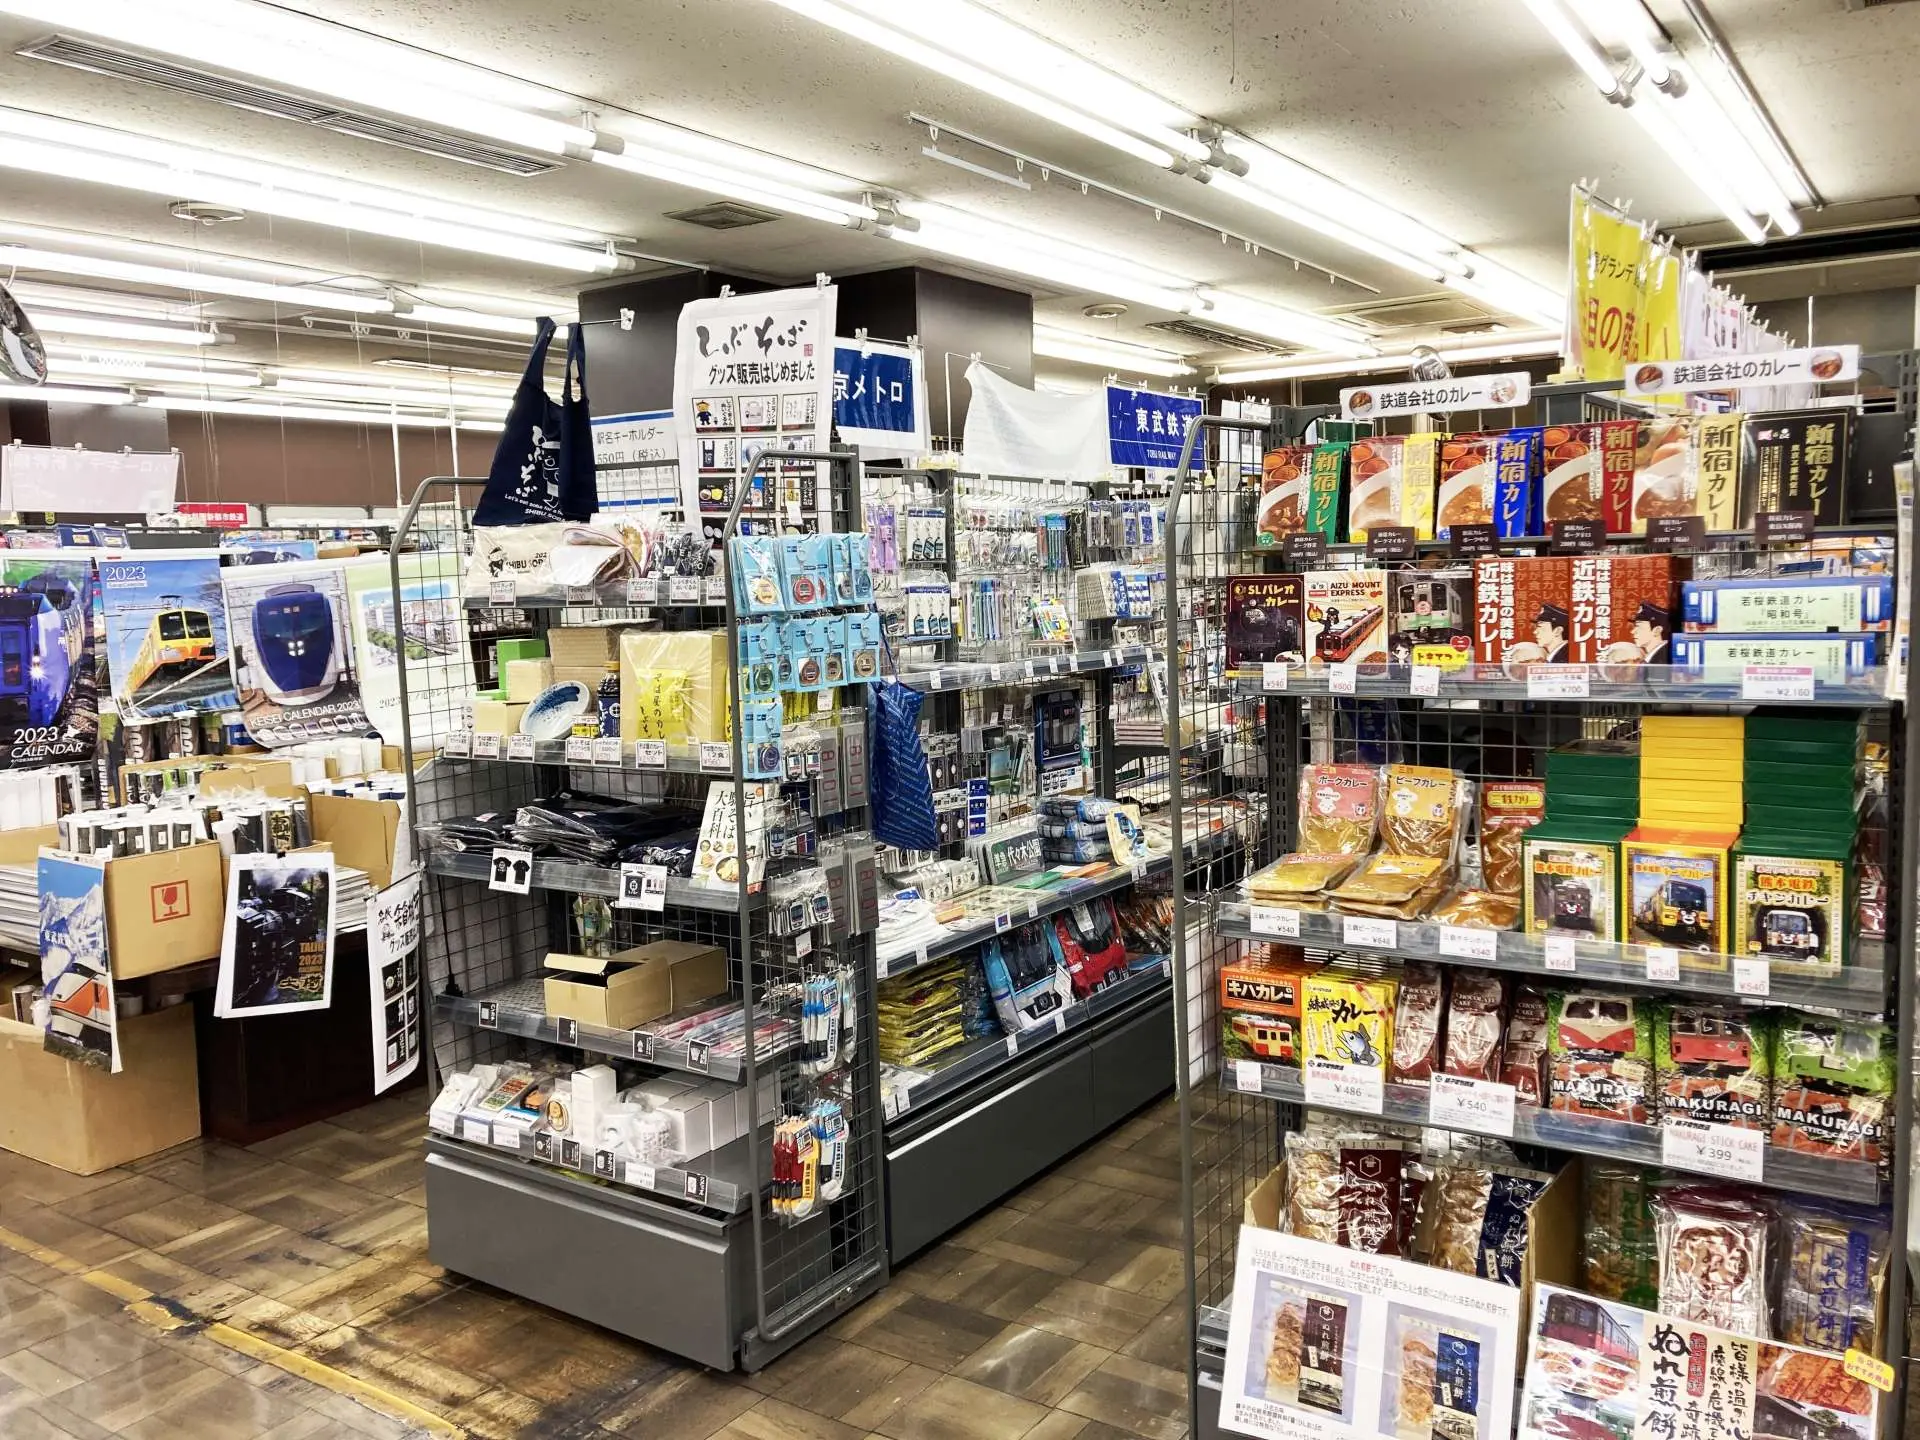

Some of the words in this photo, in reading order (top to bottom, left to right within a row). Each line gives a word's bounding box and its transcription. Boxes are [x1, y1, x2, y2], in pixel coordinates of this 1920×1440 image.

[709, 360, 815, 385] グッズ販売はじめました
[1673, 362, 1801, 384] 鉄道会社のカレー
[1380, 387, 1482, 409] 鉄道会社のカレー
[1136, 408, 1193, 437] 東武鉄道
[1606, 423, 1636, 530] 新宿カレー
[1703, 424, 1734, 530] 新宿カレー
[1804, 423, 1837, 516] 新宿カレー
[1313, 451, 1338, 532] 新宿カレー
[1406, 440, 1433, 539] 新宿カレー
[1499, 439, 1530, 538] 新宿カレー
[105, 566, 146, 581] 2023
[1247, 584, 1295, 596] SLパレオ
[1330, 582, 1350, 590] AIZU
[1352, 581, 1382, 589] MOUNT
[1330, 588, 1365, 597] EXPRESS
[1265, 596, 1299, 607] カレー
[1741, 595, 1830, 607] 若桜鉄道カレー
[1478, 562, 1499, 662] 近鉄カレー
[1572, 560, 1595, 662] 近鉄カレー
[1727, 647, 1816, 658] 若桜鉄道カレー
[249, 713, 282, 728] KEISEI
[282, 704, 336, 722] CALENDAR
[336, 700, 361, 713] 2023
[13, 727, 59, 745] 2023
[11, 743, 84, 759] CALENDAR
[1319, 776, 1368, 788] ポークカレー
[1396, 776, 1446, 788] ビーフカレー
[1747, 891, 1829, 906] チキンカレー
[299, 955, 324, 966] 2023
[1227, 981, 1294, 1006] キハカレー
[1334, 1084, 1362, 1097] ¥486
[1553, 1079, 1645, 1098] MAKURAGI
[1457, 1097, 1487, 1112] ¥540
[1664, 1096, 1762, 1116] MAKURAGI
[1687, 1110, 1711, 1119] STICK
[1777, 1106, 1882, 1138] MAKURAGI
[1668, 1128, 1706, 1144] MAKURAGI
[1711, 1135, 1736, 1148] STICK
[1738, 1139, 1759, 1152] CAKE
[1696, 1145, 1732, 1161] ¥399
[1641, 1323, 1693, 1440] ぬれ煎餅
